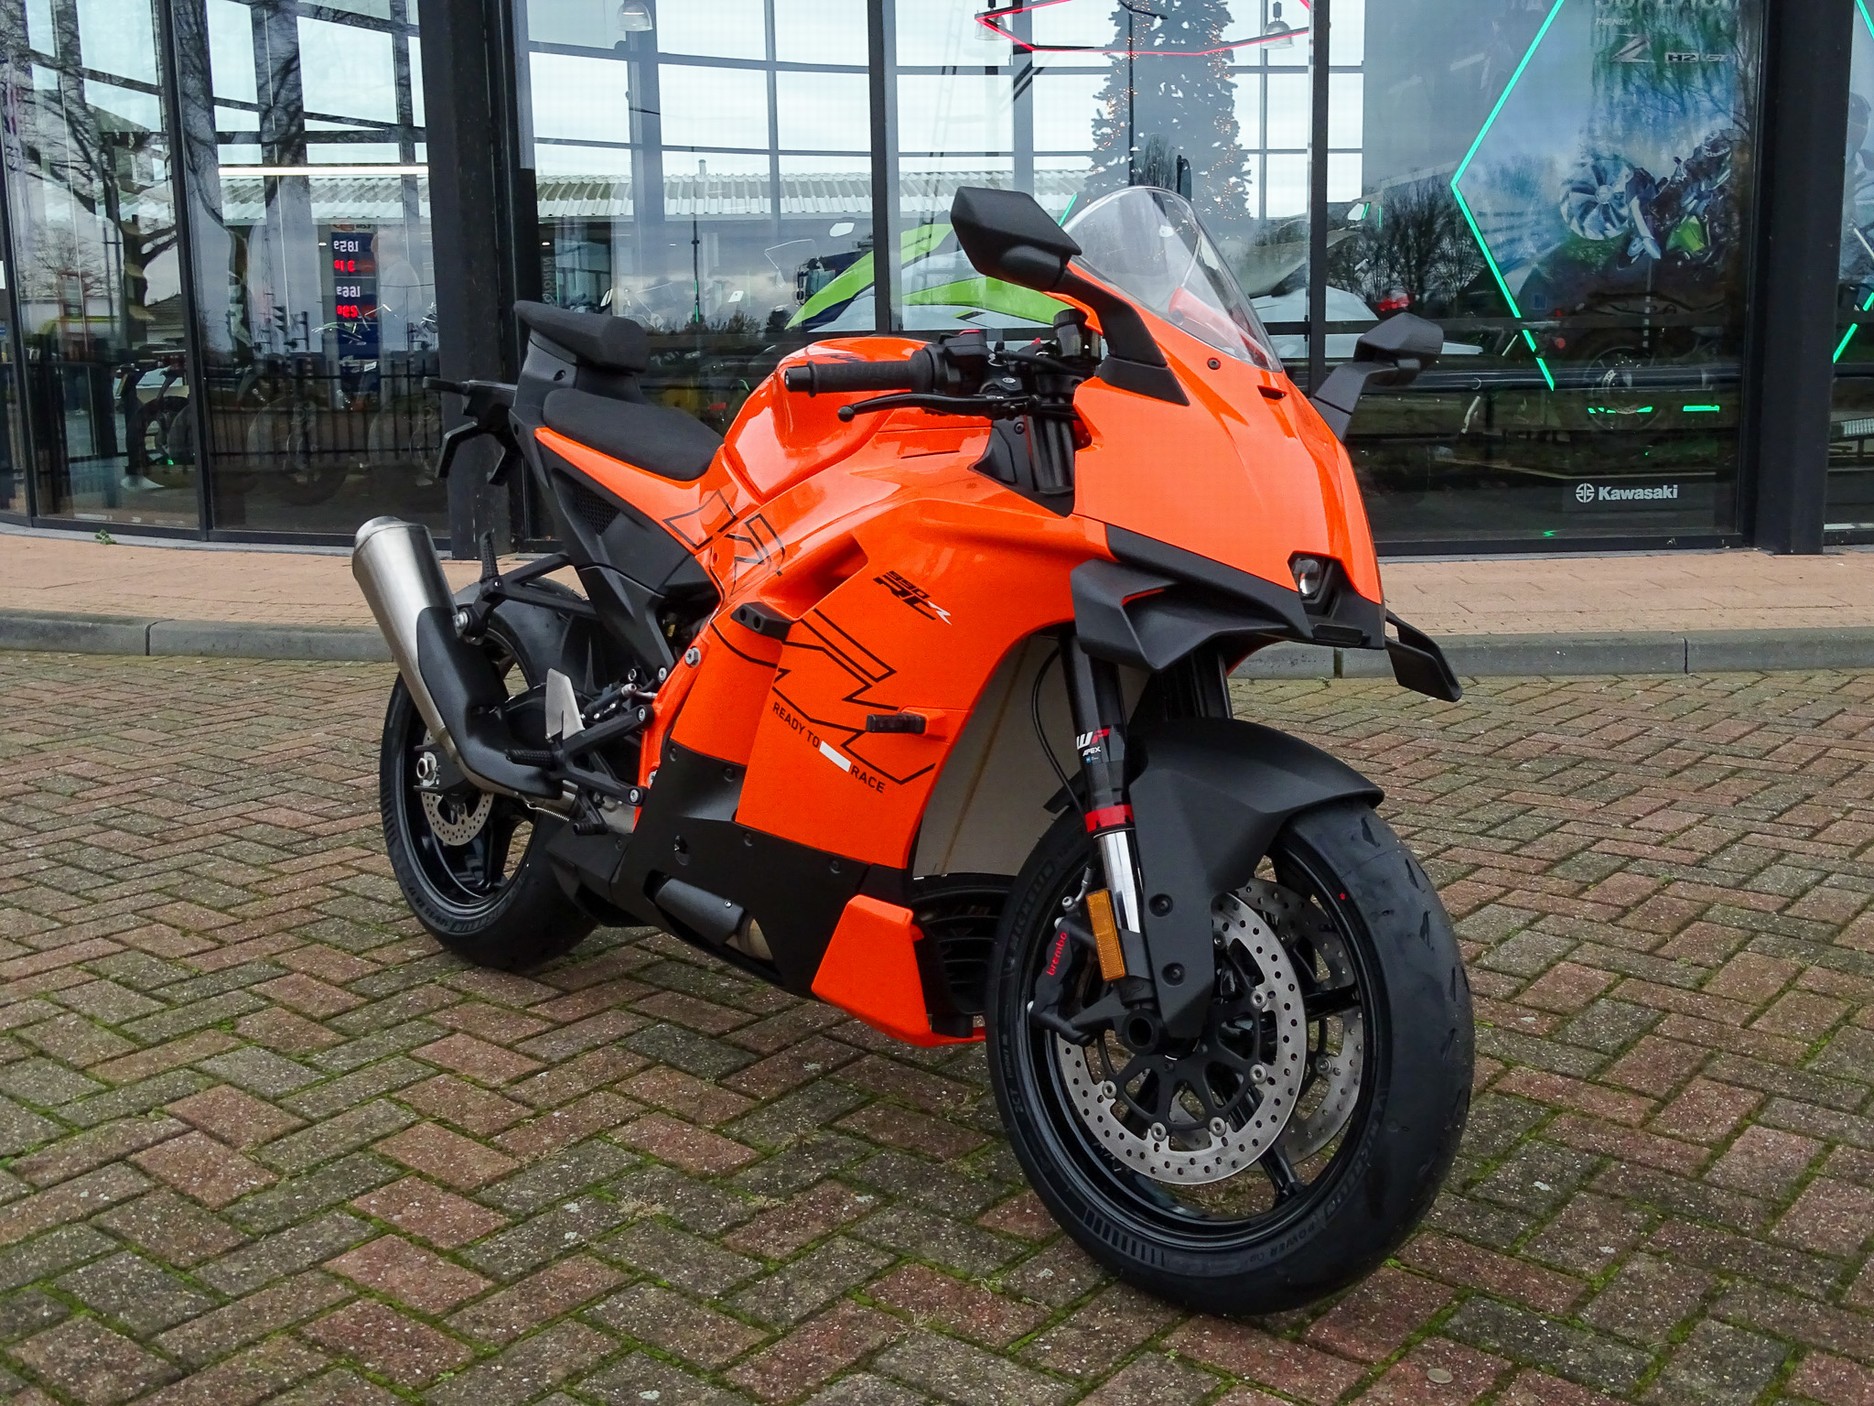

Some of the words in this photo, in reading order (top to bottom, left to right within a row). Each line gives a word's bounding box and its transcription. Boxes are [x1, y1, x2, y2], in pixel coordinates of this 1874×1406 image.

[1666, 53, 1698, 62] H2
[1598, 484, 1679, 500] Kawasaki
[886, 570, 931, 600] 990
[772, 701, 806, 735] READY
[807, 730, 821, 749] TO
[850, 765, 886, 794] RACE
[1082, 746, 1101, 757] APEX
[1046, 931, 1068, 976] brembo
[1269, 1221, 1315, 1257] POWER
